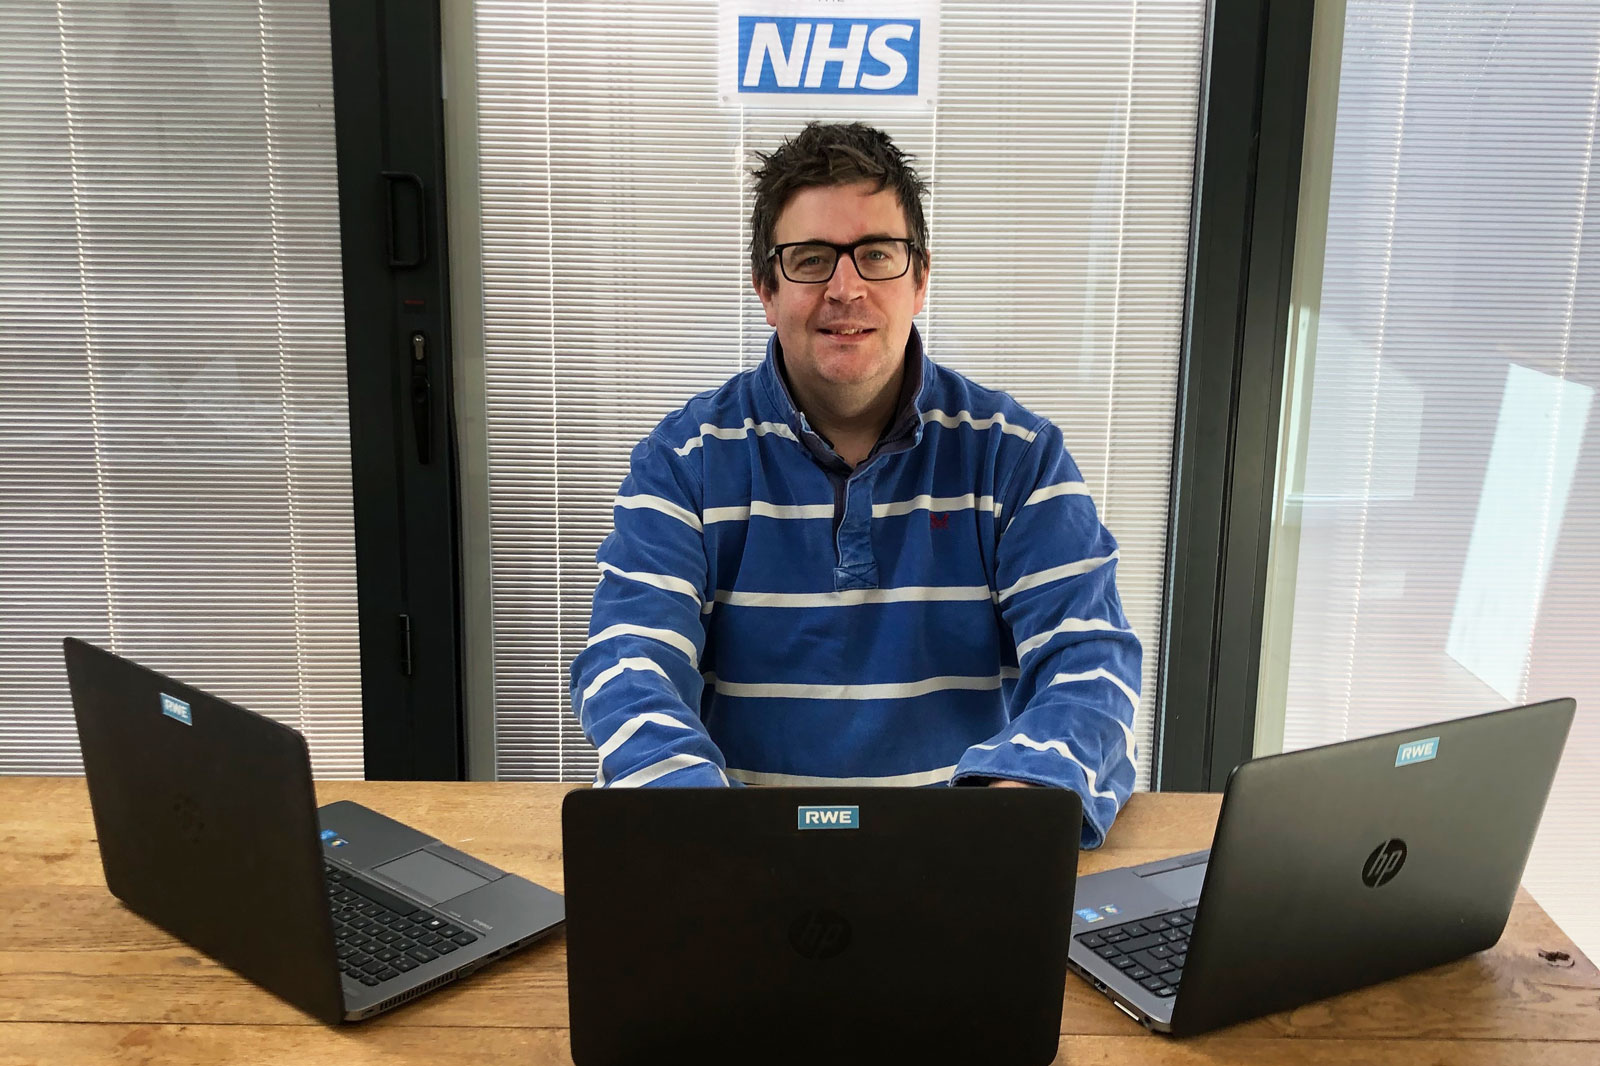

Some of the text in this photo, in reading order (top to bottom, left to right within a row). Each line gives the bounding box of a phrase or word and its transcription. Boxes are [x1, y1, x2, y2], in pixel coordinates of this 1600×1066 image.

[742, 22, 914, 90] NHS
[1401, 742, 1434, 760] RWE
[805, 810, 852, 824] RWE
[1367, 840, 1403, 888] hp
